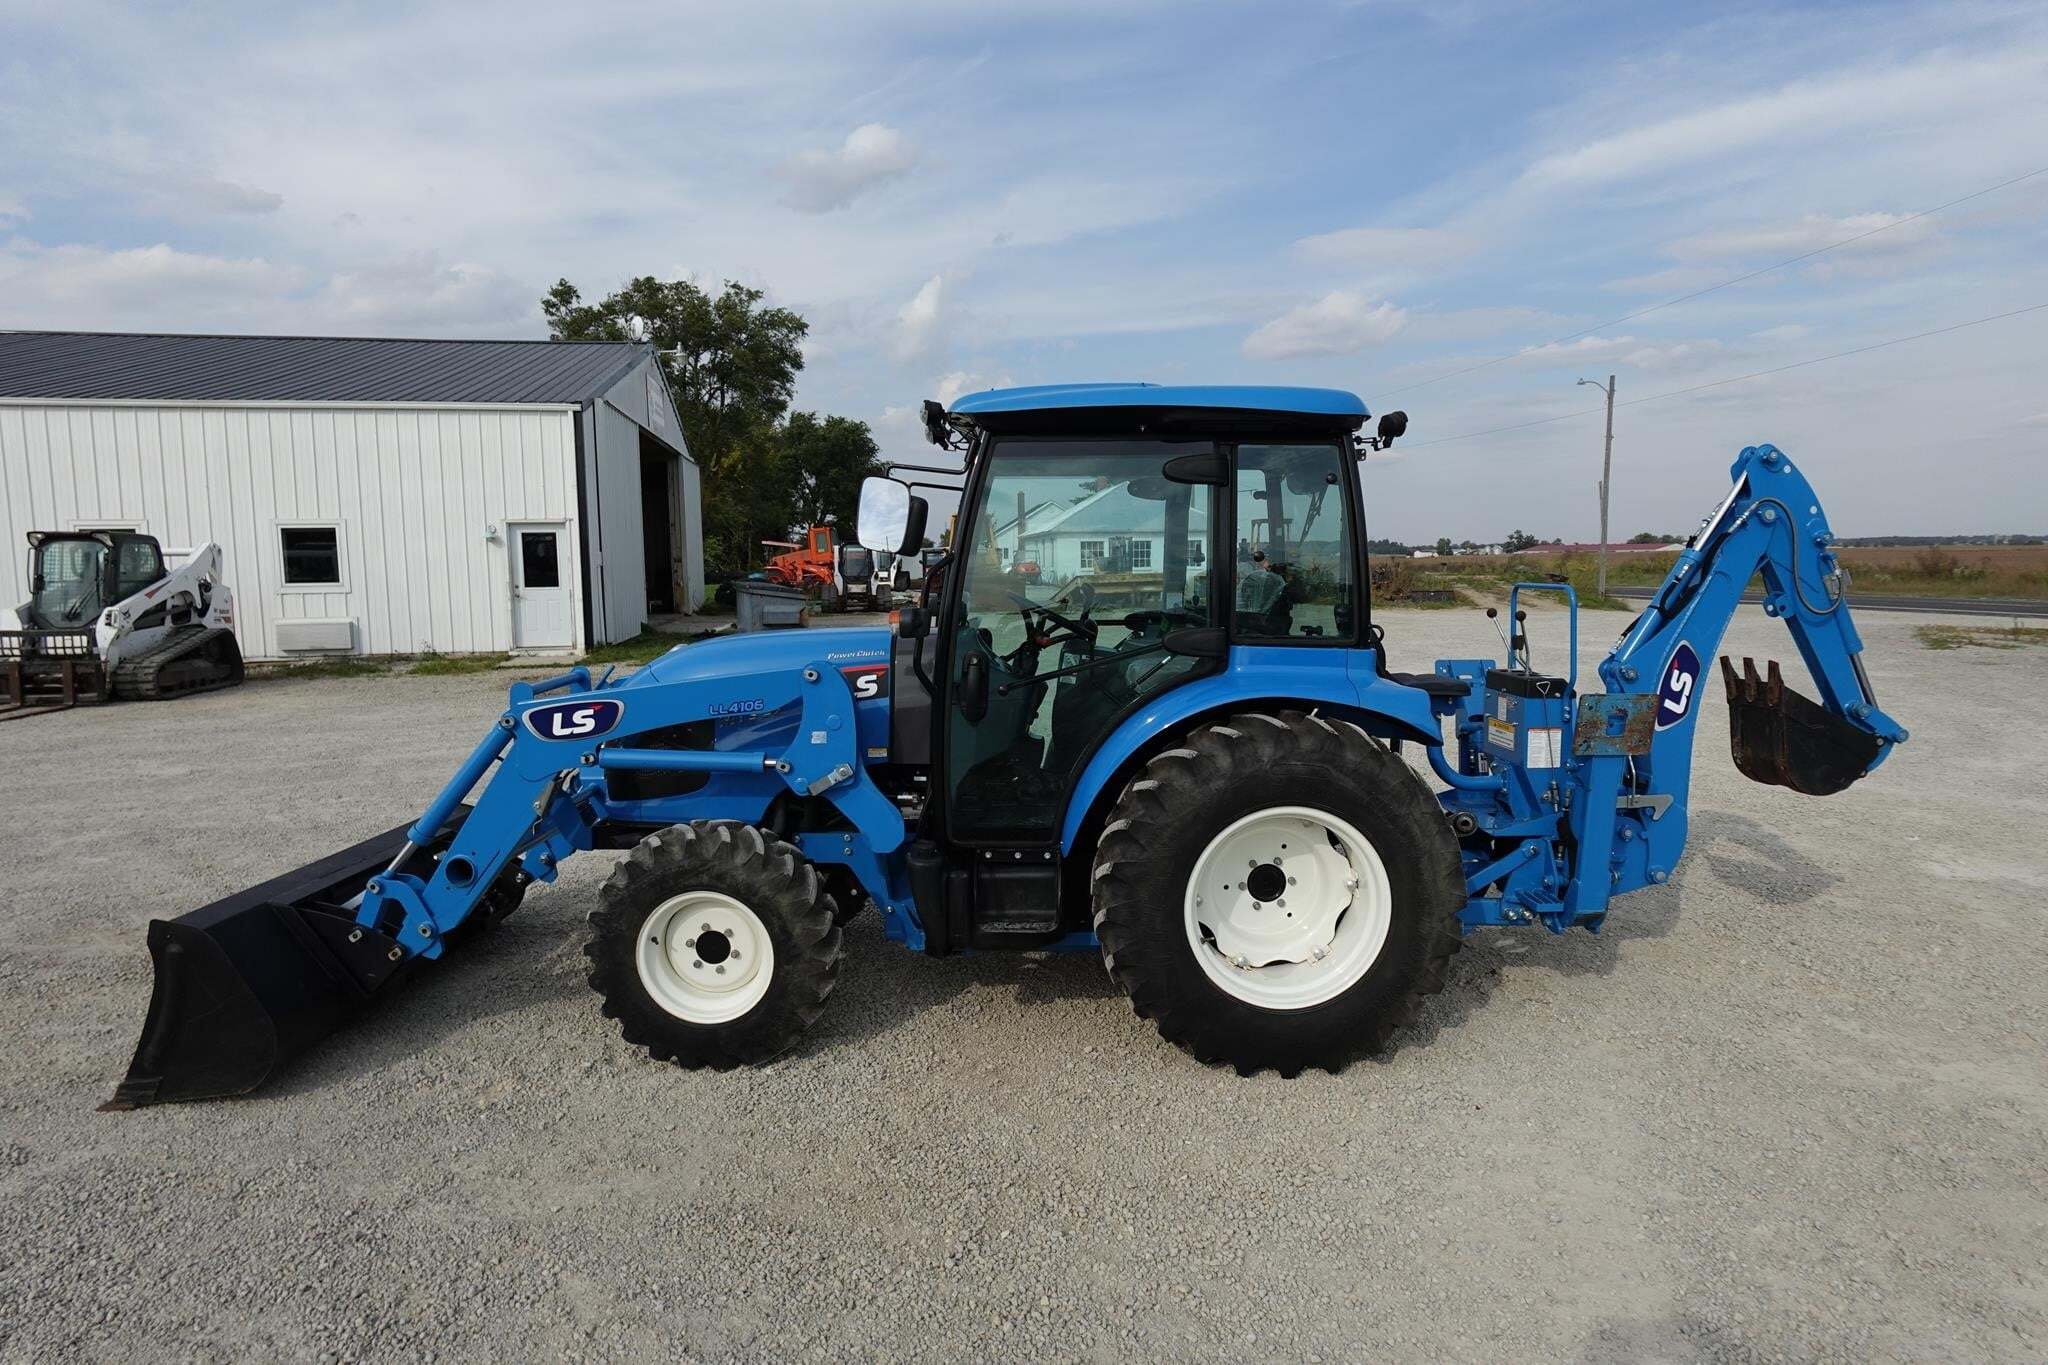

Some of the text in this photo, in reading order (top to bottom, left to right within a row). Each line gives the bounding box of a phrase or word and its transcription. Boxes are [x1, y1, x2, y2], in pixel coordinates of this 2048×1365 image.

[854, 674, 878, 698] S
[1663, 669, 1693, 714] LS
[709, 699, 764, 715] LL4106
[552, 709, 596, 737] LS
